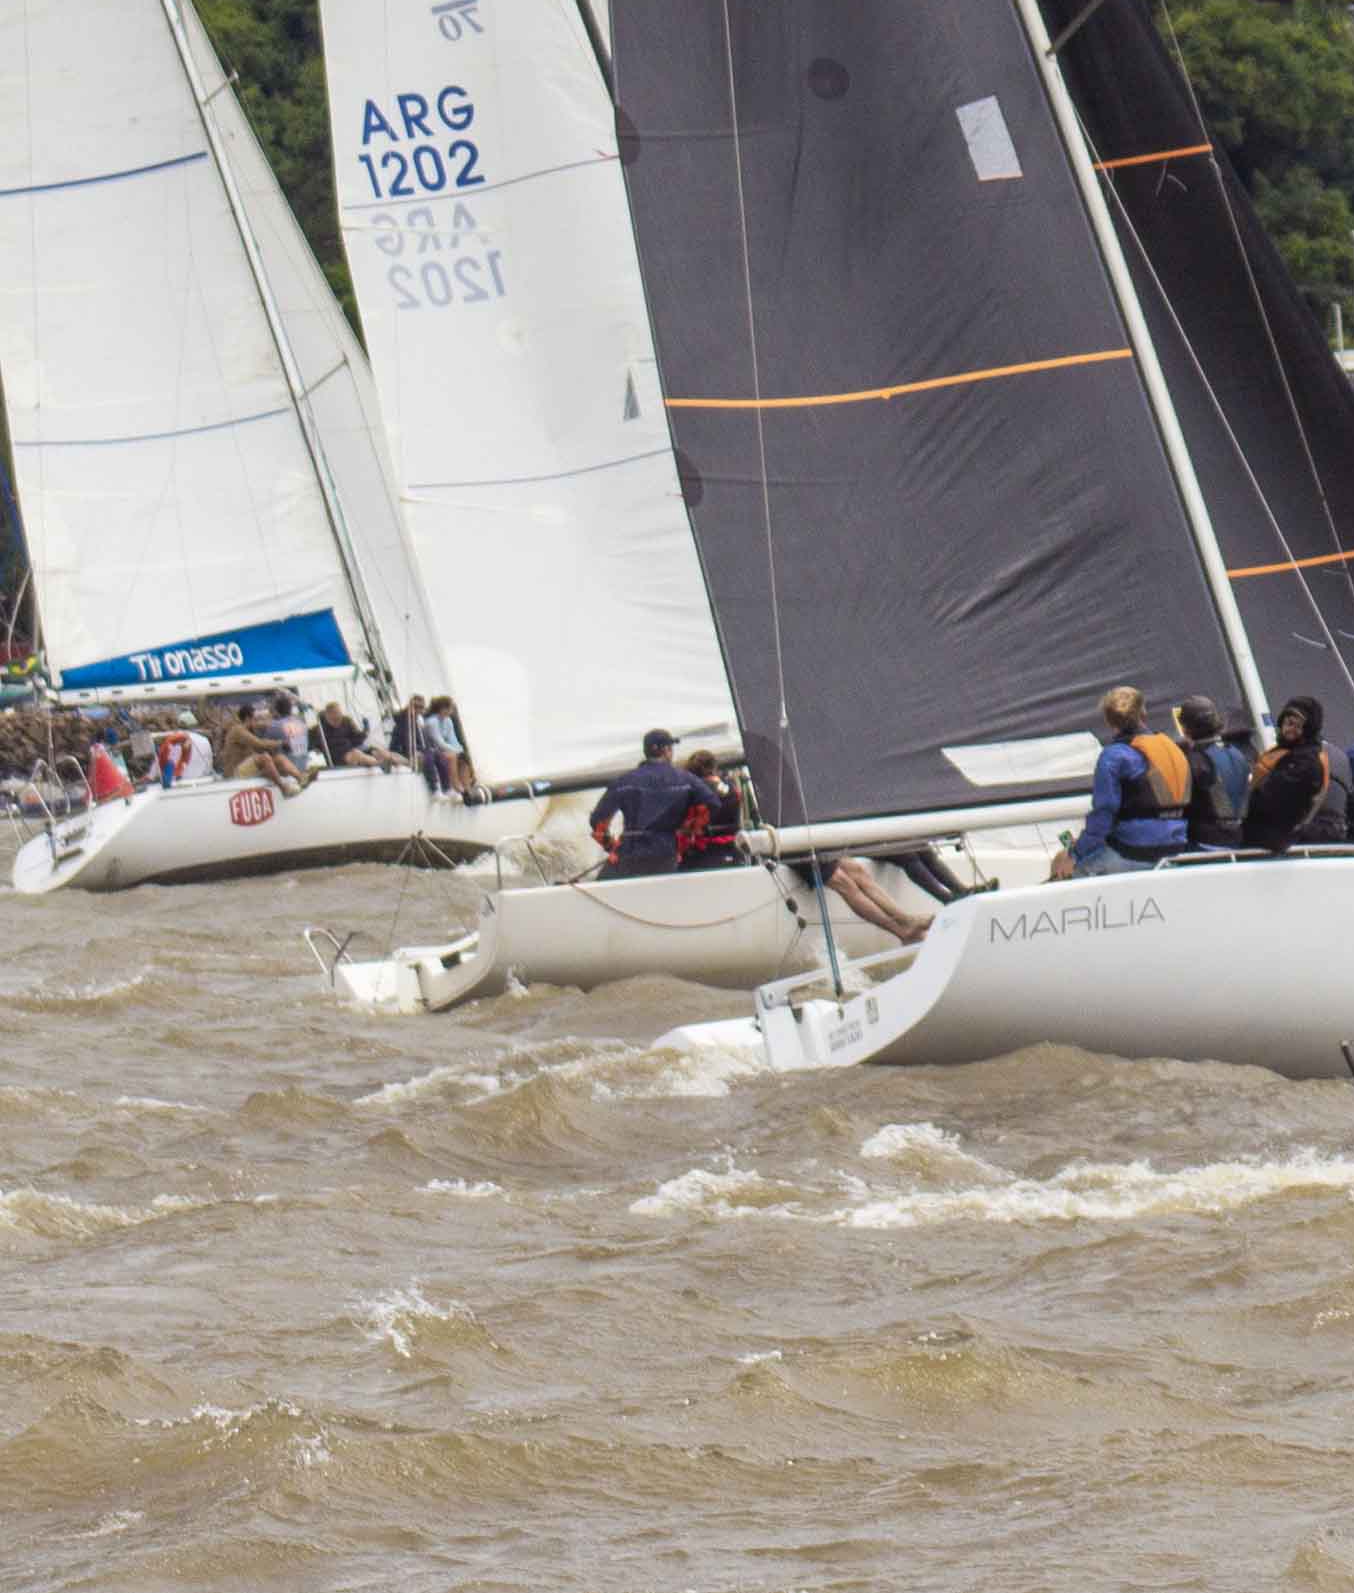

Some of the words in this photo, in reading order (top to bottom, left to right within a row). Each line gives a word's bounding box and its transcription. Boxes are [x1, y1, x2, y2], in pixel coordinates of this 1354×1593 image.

[362, 85, 475, 145] ARG
[358, 140, 486, 198] 1202
[232, 790, 273, 824] FUGA
[990, 895, 1166, 944] MARÍLIA
